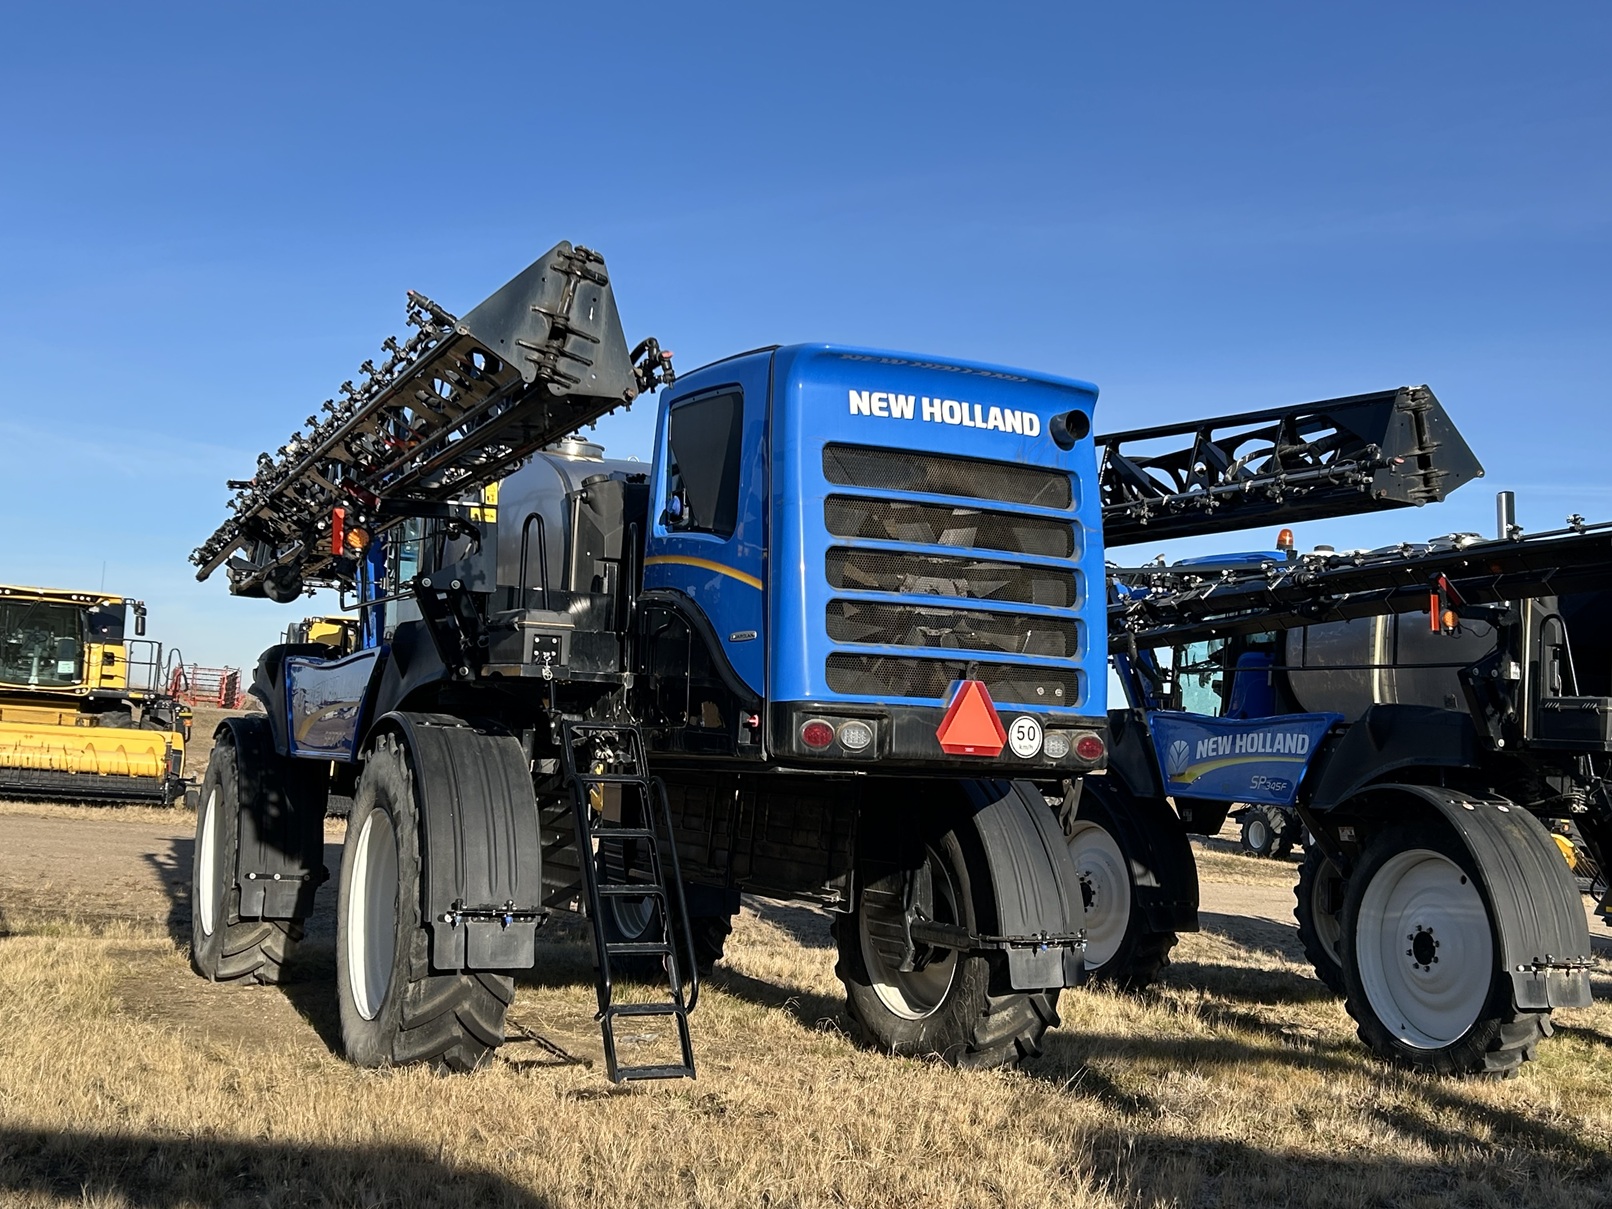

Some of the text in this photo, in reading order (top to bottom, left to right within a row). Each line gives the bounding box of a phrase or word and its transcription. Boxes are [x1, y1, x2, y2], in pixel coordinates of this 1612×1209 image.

[848, 389, 1041, 437] NEW HOLLAND
[1016, 725, 1036, 741] 50
[1196, 732, 1310, 760] NEW HOLLAND
